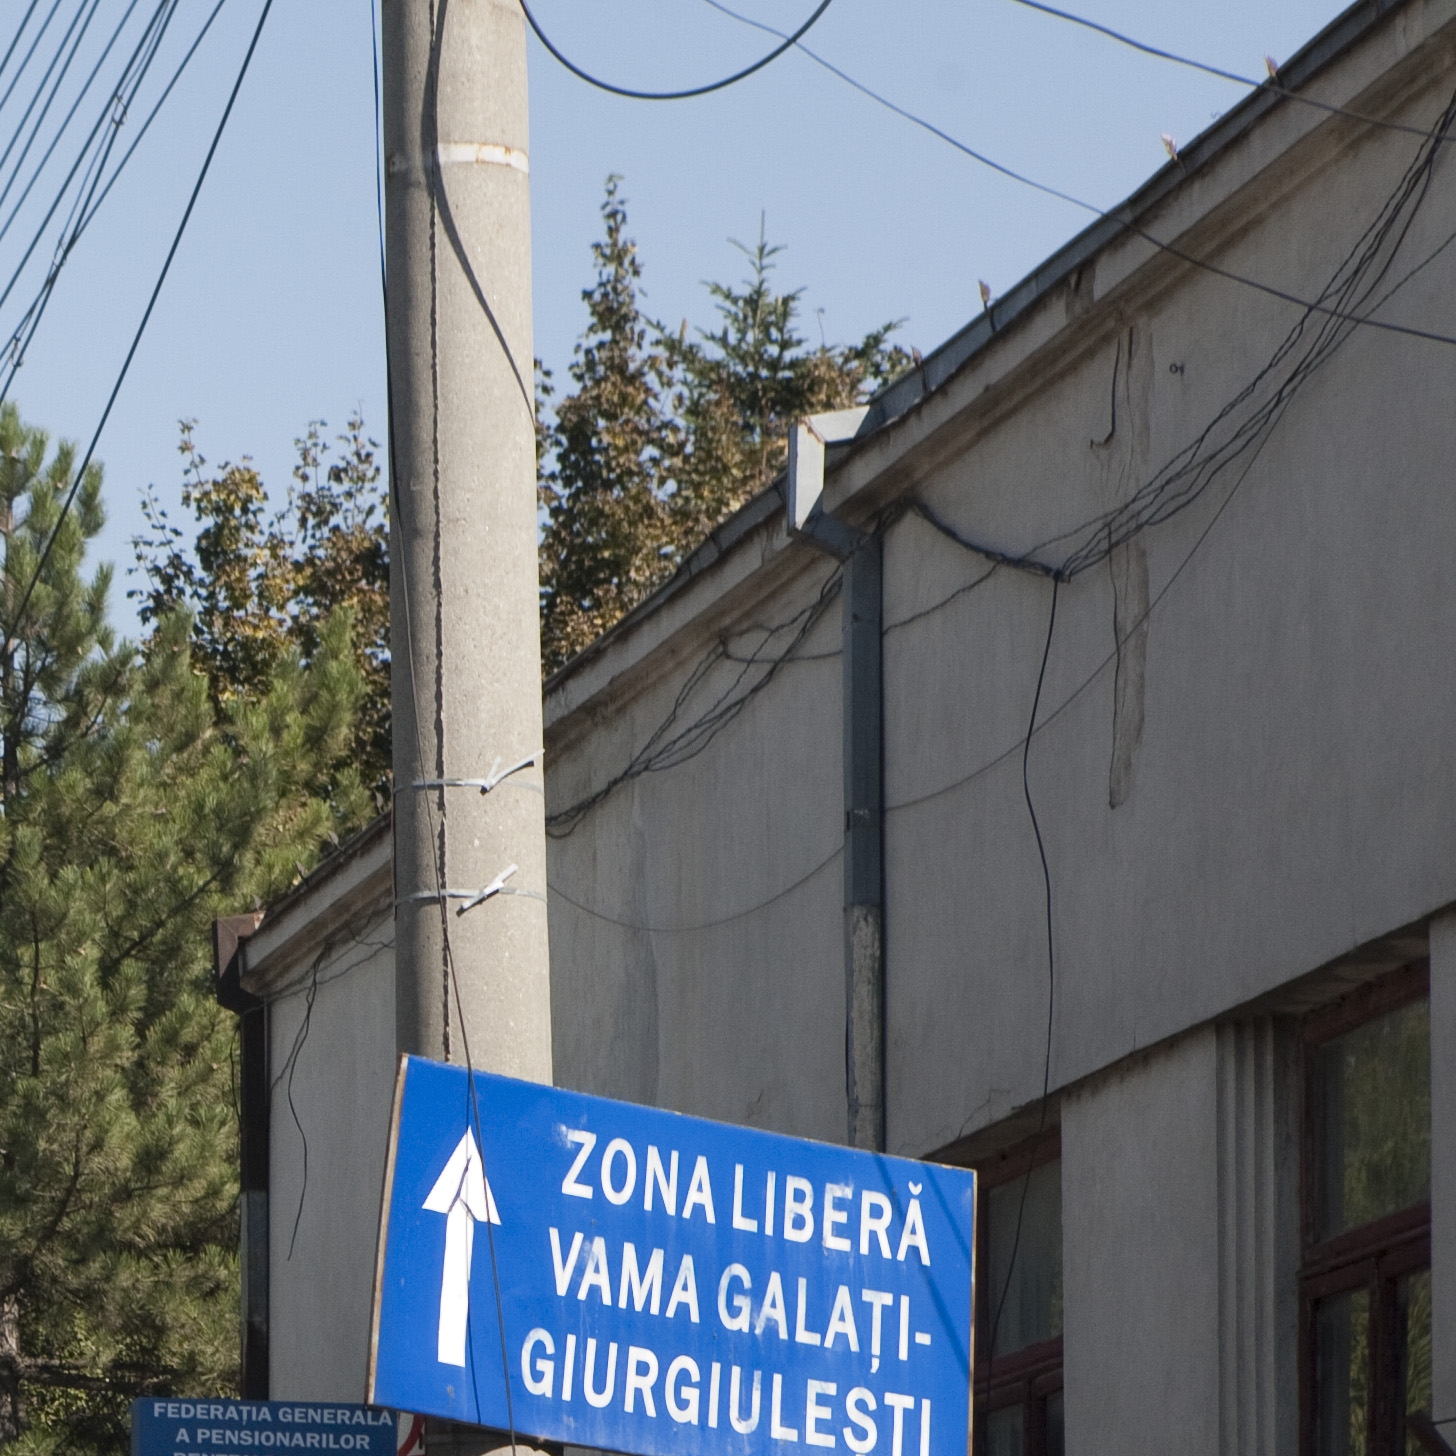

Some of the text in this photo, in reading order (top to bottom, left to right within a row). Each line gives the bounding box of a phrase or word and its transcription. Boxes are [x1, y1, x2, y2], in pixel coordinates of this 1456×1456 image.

[561, 1127, 931, 1267] ZONA LIBERĂ
[548, 1226, 700, 1324] VAMA
[153, 1402, 272, 1426] FEDERAȚIA
[175, 1428, 370, 1450] A PENSIONARILOR
